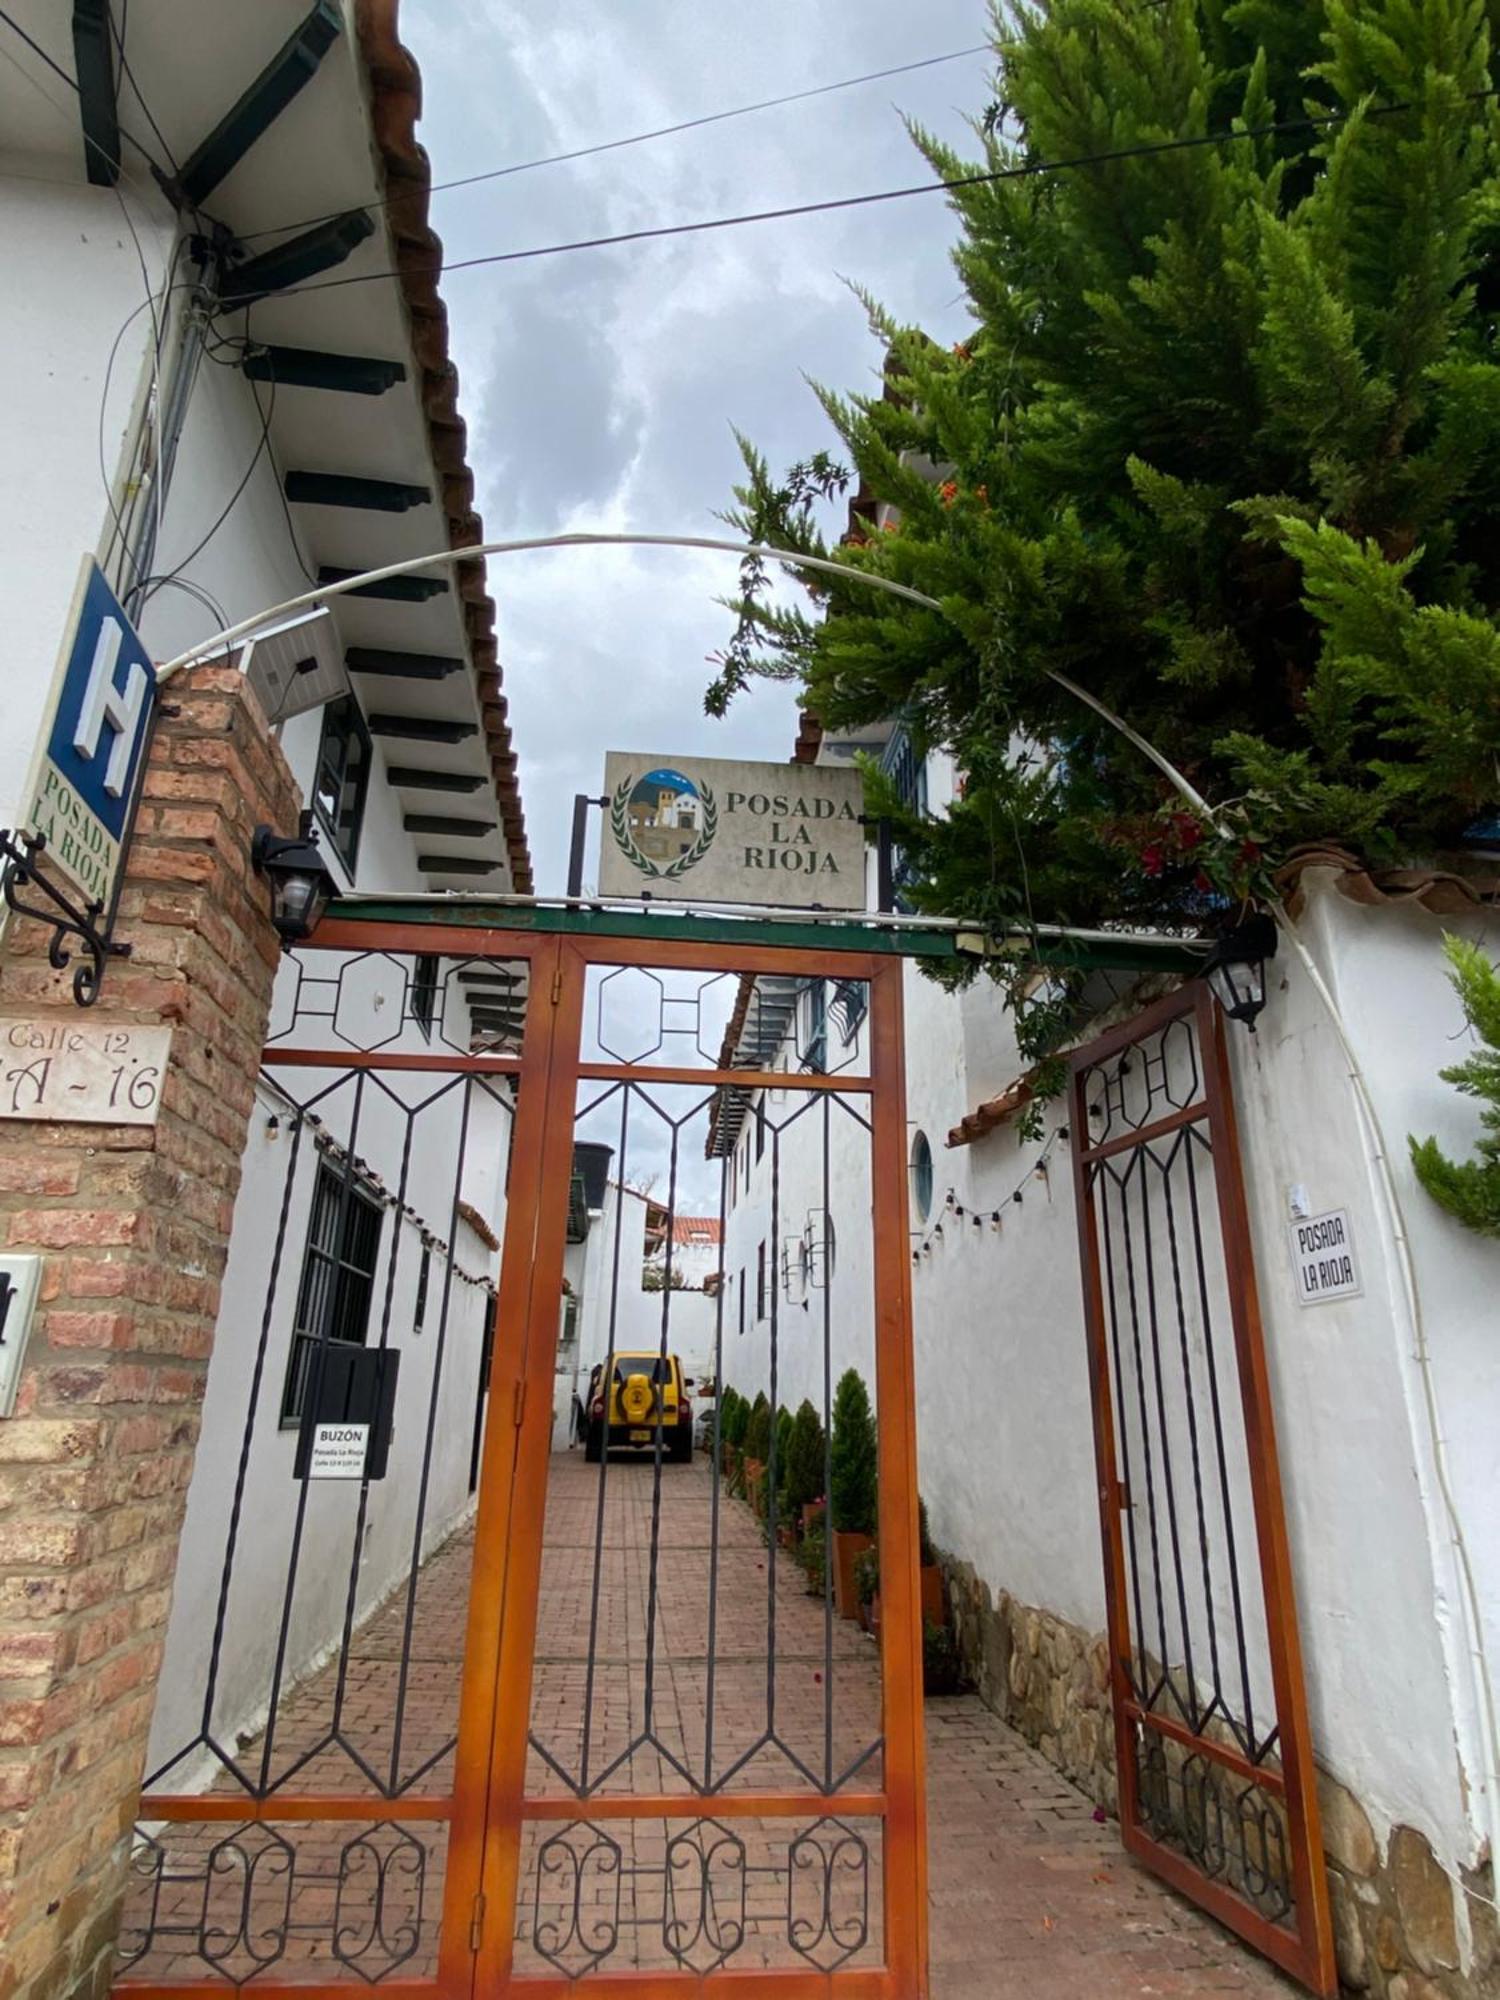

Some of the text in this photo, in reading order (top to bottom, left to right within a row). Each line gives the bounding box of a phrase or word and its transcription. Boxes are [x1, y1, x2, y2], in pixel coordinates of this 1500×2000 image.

[73, 616, 148, 798] H
[44, 770, 112, 868] POSADA
[724, 791, 857, 821] POSADA
[31, 798, 108, 902] LA RIOJA
[770, 822, 812, 845] LA
[744, 847, 840, 875] RIOJA
[8, 1023, 130, 1054] Calle 12
[110, 1066, 159, 1109] 16
[1298, 1217, 1345, 1255] POSADA
[1302, 1255, 1354, 1292] LA RIOJA
[320, 1429, 362, 1442] BUZÓN
